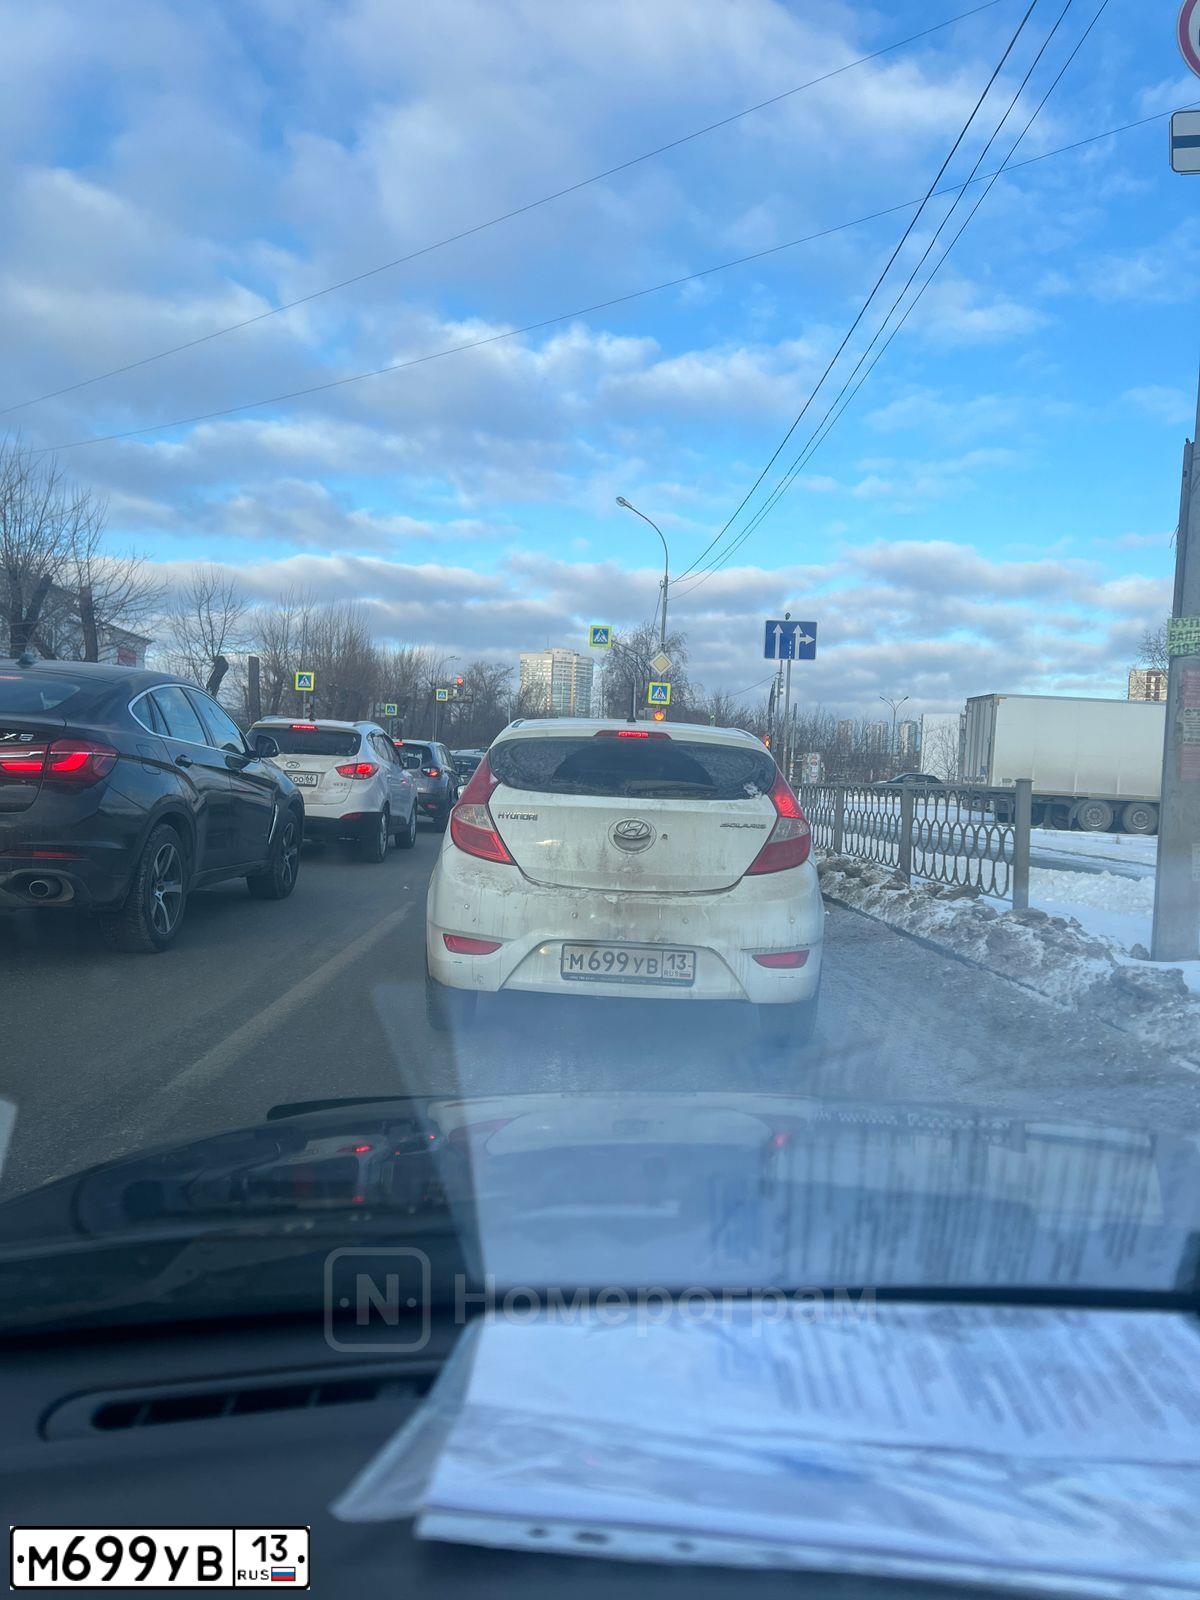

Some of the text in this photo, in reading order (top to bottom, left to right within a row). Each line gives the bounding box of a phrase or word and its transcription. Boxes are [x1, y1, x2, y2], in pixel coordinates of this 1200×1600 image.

[498, 811, 538, 821] HYUNDAI
[569, 950, 687, 975] М699УВ 13
[663, 970, 679, 978] RUS
